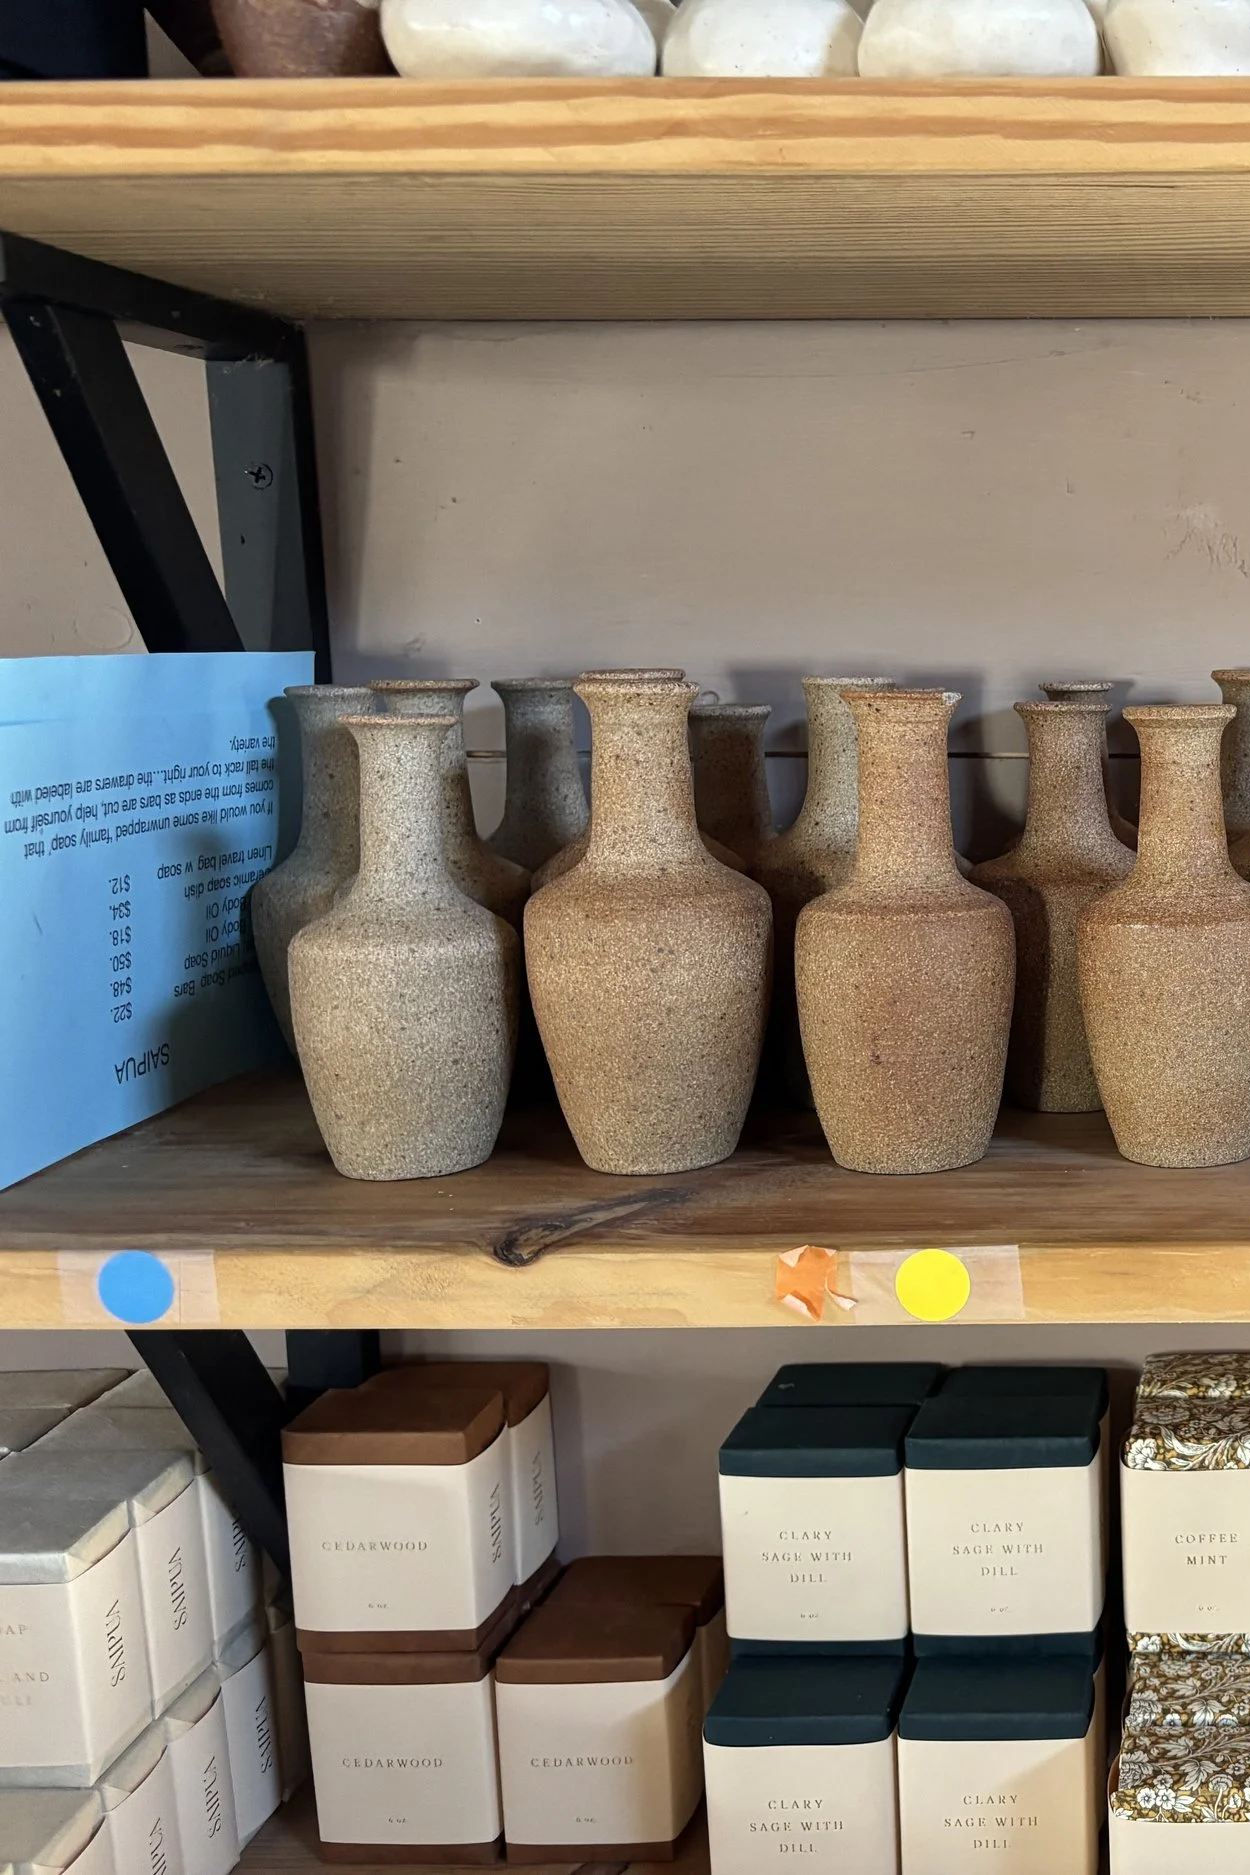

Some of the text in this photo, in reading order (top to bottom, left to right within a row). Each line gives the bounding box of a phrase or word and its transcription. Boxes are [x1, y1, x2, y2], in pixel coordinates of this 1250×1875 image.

[229, 735, 276, 752] the variety.
[188, 761, 211, 778] your
[212, 762, 222, 777] to
[224, 760, 244, 777] rack
[246, 758, 259, 775] tall
[261, 757, 275, 770] the
[75, 779, 93, 794] are
[95, 773, 135, 790] drawers
[244, 779, 274, 794] comes
[35, 782, 73, 804] labeled
[164, 792, 176, 805] as
[179, 788, 202, 805] ends
[204, 786, 220, 802] the
[222, 783, 243, 798] from
[121, 798, 138, 811] are
[139, 794, 161, 809] bars
[250, 798, 266, 813] you
[266, 801, 273, 815] If
[30, 804, 73, 832] yourself
[75, 802, 98, 822] help
[173, 812, 200, 827] some
[202, 810, 218, 825] like
[219, 805, 247, 823] would
[4, 816, 29, 834] from
[115, 818, 171, 842] unwrapped
[24, 840, 45, 859] that
[109, 845, 272, 894] Linen travel bag w soap $12.
[184, 883, 204, 900] dish
[208, 878, 230, 893] soap
[109, 899, 131, 920] $34.
[206, 903, 219, 920] Oil
[109, 925, 132, 946] $18.
[109, 919, 246, 972] Body Oil $50.
[211, 943, 240, 964] Liquid
[184, 952, 208, 970] Soap
[110, 976, 132, 997] $48.
[201, 971, 224, 988] Soap
[174, 980, 195, 998] Bars
[111, 1001, 133, 1023] $22.
[114, 1042, 170, 1084] SAIPUA
[489, 1482, 502, 1564] SAIPUA
[970, 1522, 1025, 1533] CLARY
[779, 1530, 833, 1541] CLARY
[1175, 1532, 1238, 1544] COFFEE
[321, 1540, 428, 1552] CEDARWOOD
[952, 1543, 1044, 1555] SAGE WITH
[761, 1551, 853, 1562] SAGE WITH
[1186, 1555, 1228, 1566] MINT
[789, 1573, 828, 1584] DILL
[980, 1566, 1019, 1577] DILL
[168, 1546, 188, 1631] SAIPUA
[105, 1599, 126, 1687] SAIPUA
[14, 1671, 49, 1682] AND
[255, 1695, 273, 1774] SAIPUA
[341, 1758, 443, 1769] CEDARWOOD
[530, 1756, 633, 1768] CEDARWOOD
[203, 1755, 222, 1839] SAIPUA
[768, 1799, 823, 1811] CLARY
[963, 1794, 1018, 1806] CLARY
[749, 1820, 844, 1833] SAGE WITH
[944, 1816, 1038, 1828] SAGE WITH
[779, 1843, 817, 1854] DILL
[973, 1838, 1011, 1849] DILL
